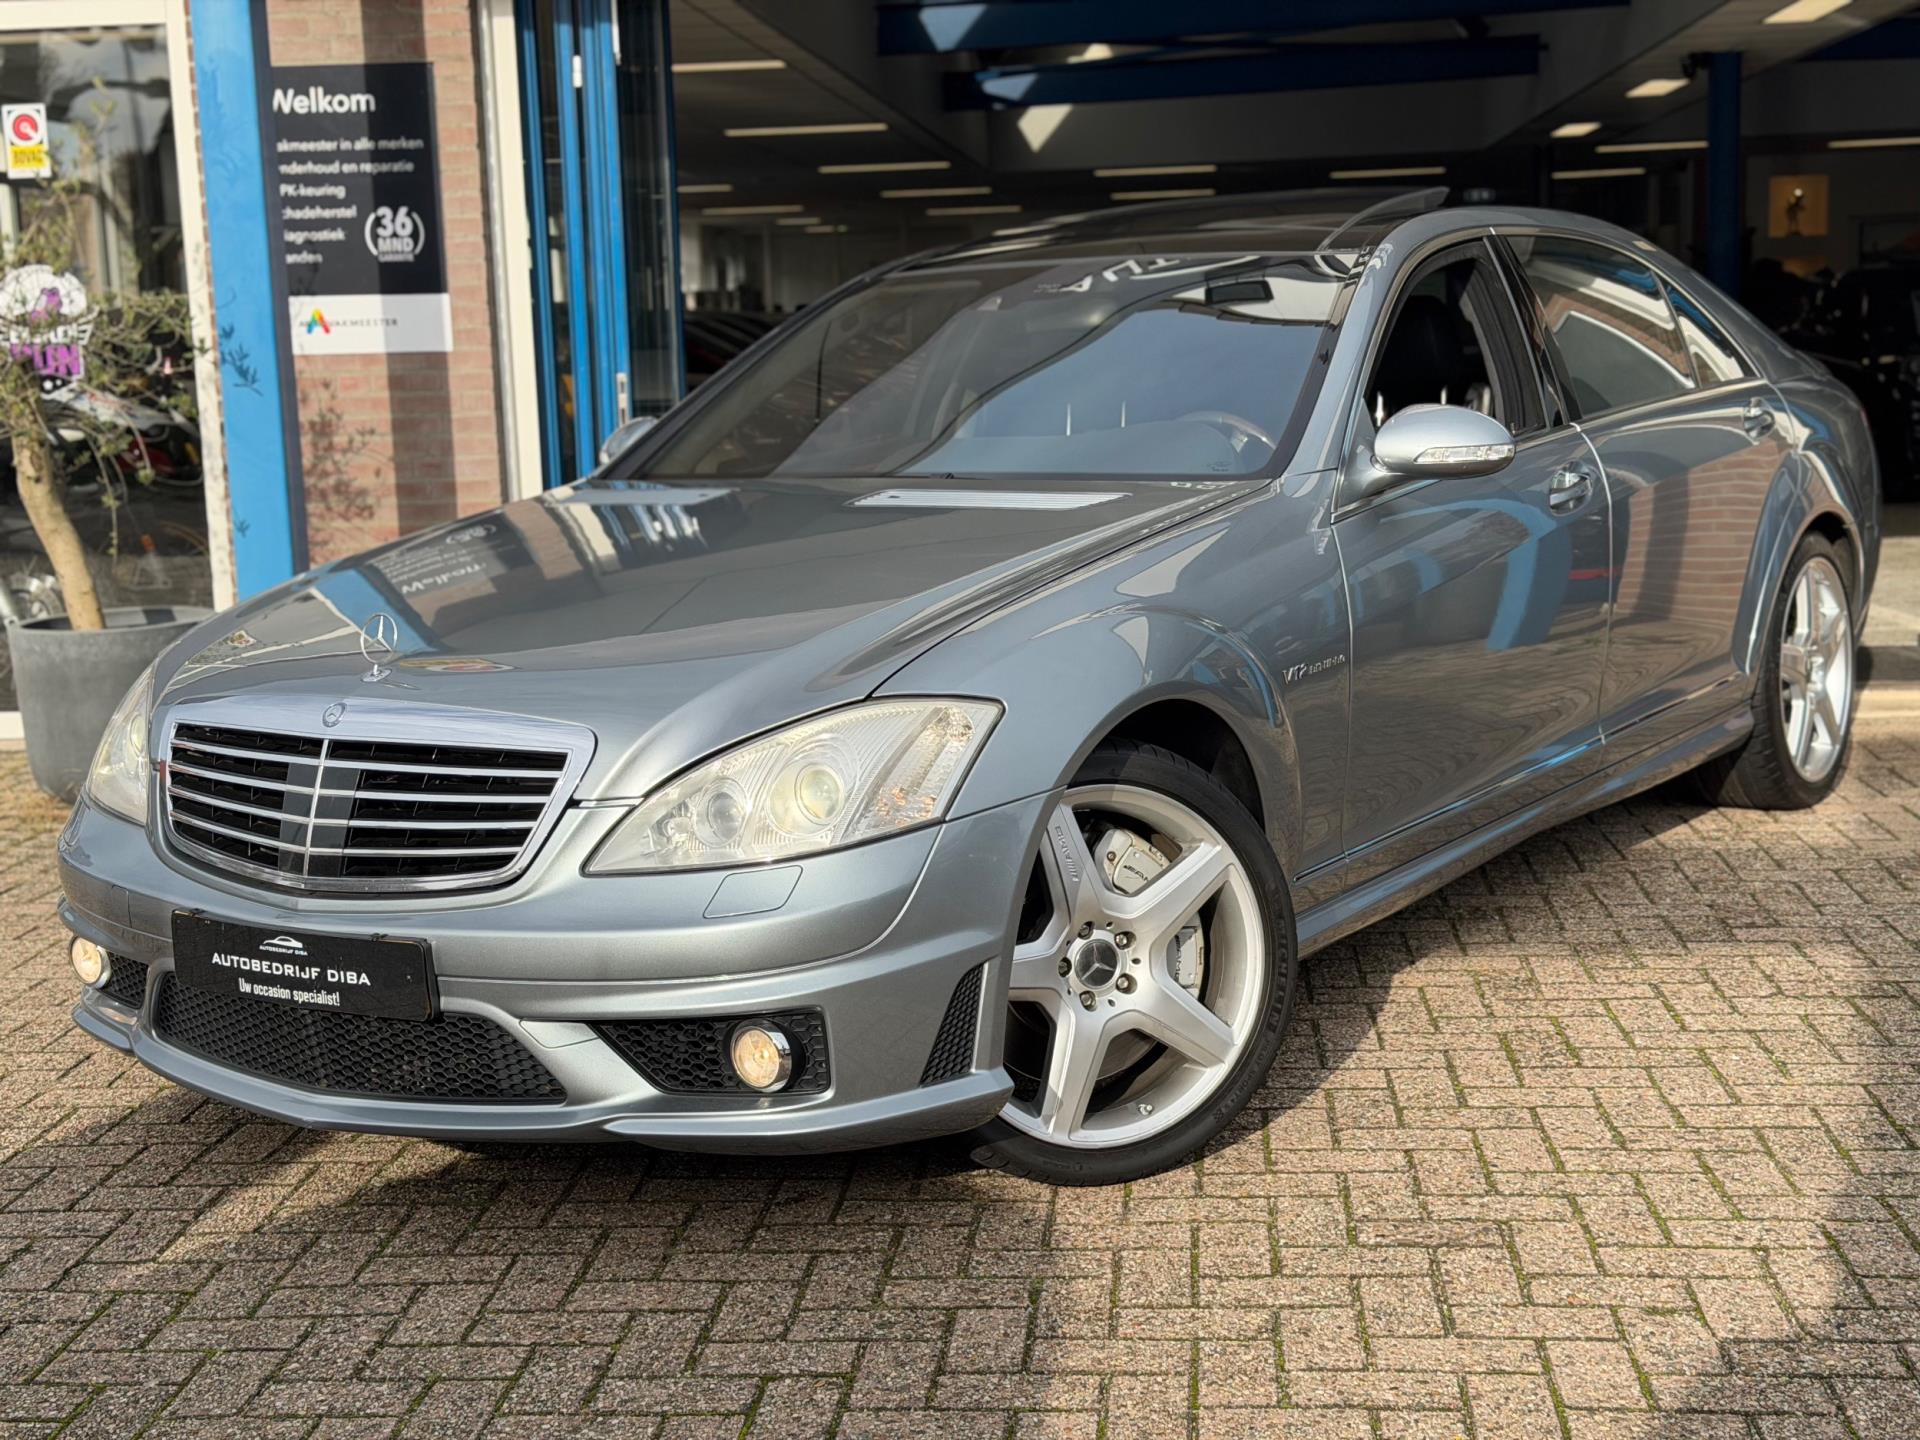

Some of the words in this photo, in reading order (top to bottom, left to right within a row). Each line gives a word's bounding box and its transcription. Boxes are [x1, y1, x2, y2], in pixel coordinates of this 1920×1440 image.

[277, 138, 338, 152] akmeester
[279, 183, 346, 199] PK-keuring
[376, 205, 414, 237] 36
[1282, 663, 1307, 684] V12
[211, 952, 321, 980] AUTOBEDRIJF
[327, 968, 371, 986] DIBA
[238, 977, 252, 994] Uw
[253, 984, 291, 1000] occasion
[293, 989, 341, 1006] specialist!
